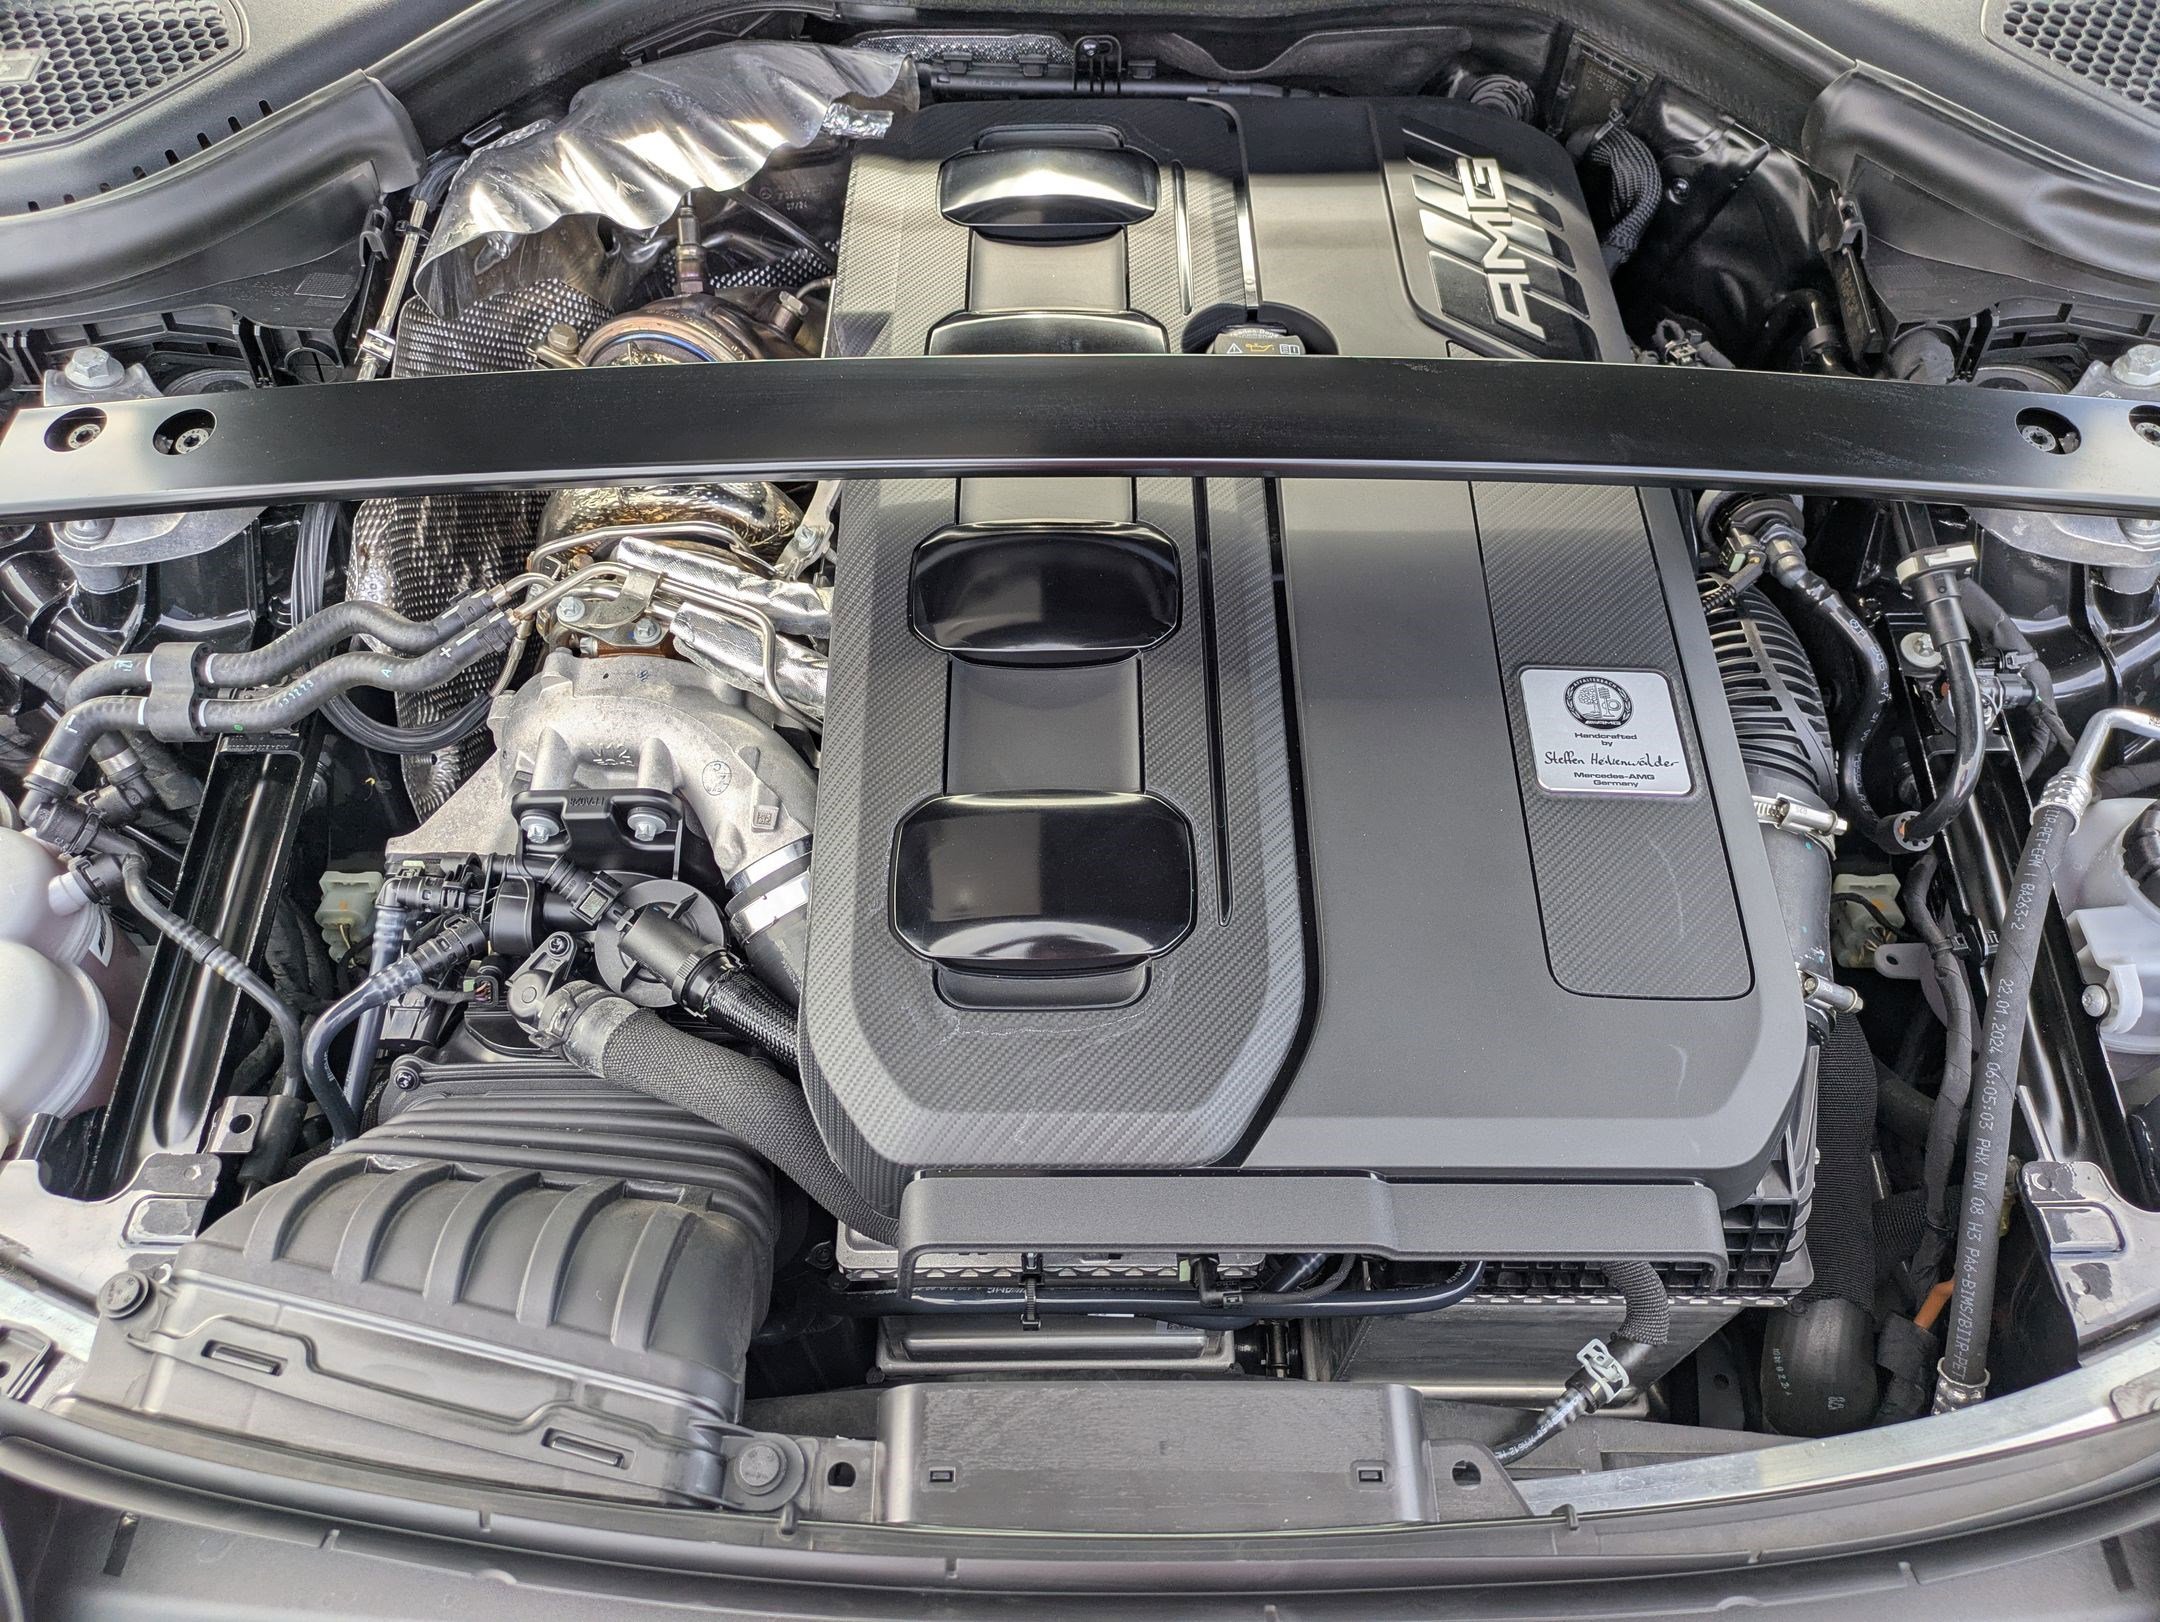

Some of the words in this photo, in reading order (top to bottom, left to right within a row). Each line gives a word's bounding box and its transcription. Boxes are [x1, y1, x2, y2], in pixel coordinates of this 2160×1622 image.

[1456, 157, 1547, 343] AMG
[1574, 732, 1637, 740] Handcrafted
[1601, 739, 1613, 747] by
[1544, 751, 1585, 765] Steffen
[1574, 772, 1655, 780] Mercedes-AMG
[1593, 779, 1639, 787] Germany
[1988, 977, 2015, 1055] 22.01.2024
[1979, 1061, 2001, 1131] 06:05:03
[1972, 1170, 1989, 1192] DN
[1970, 1196, 1986, 1215] 08
[1966, 1221, 1984, 1242] H3
